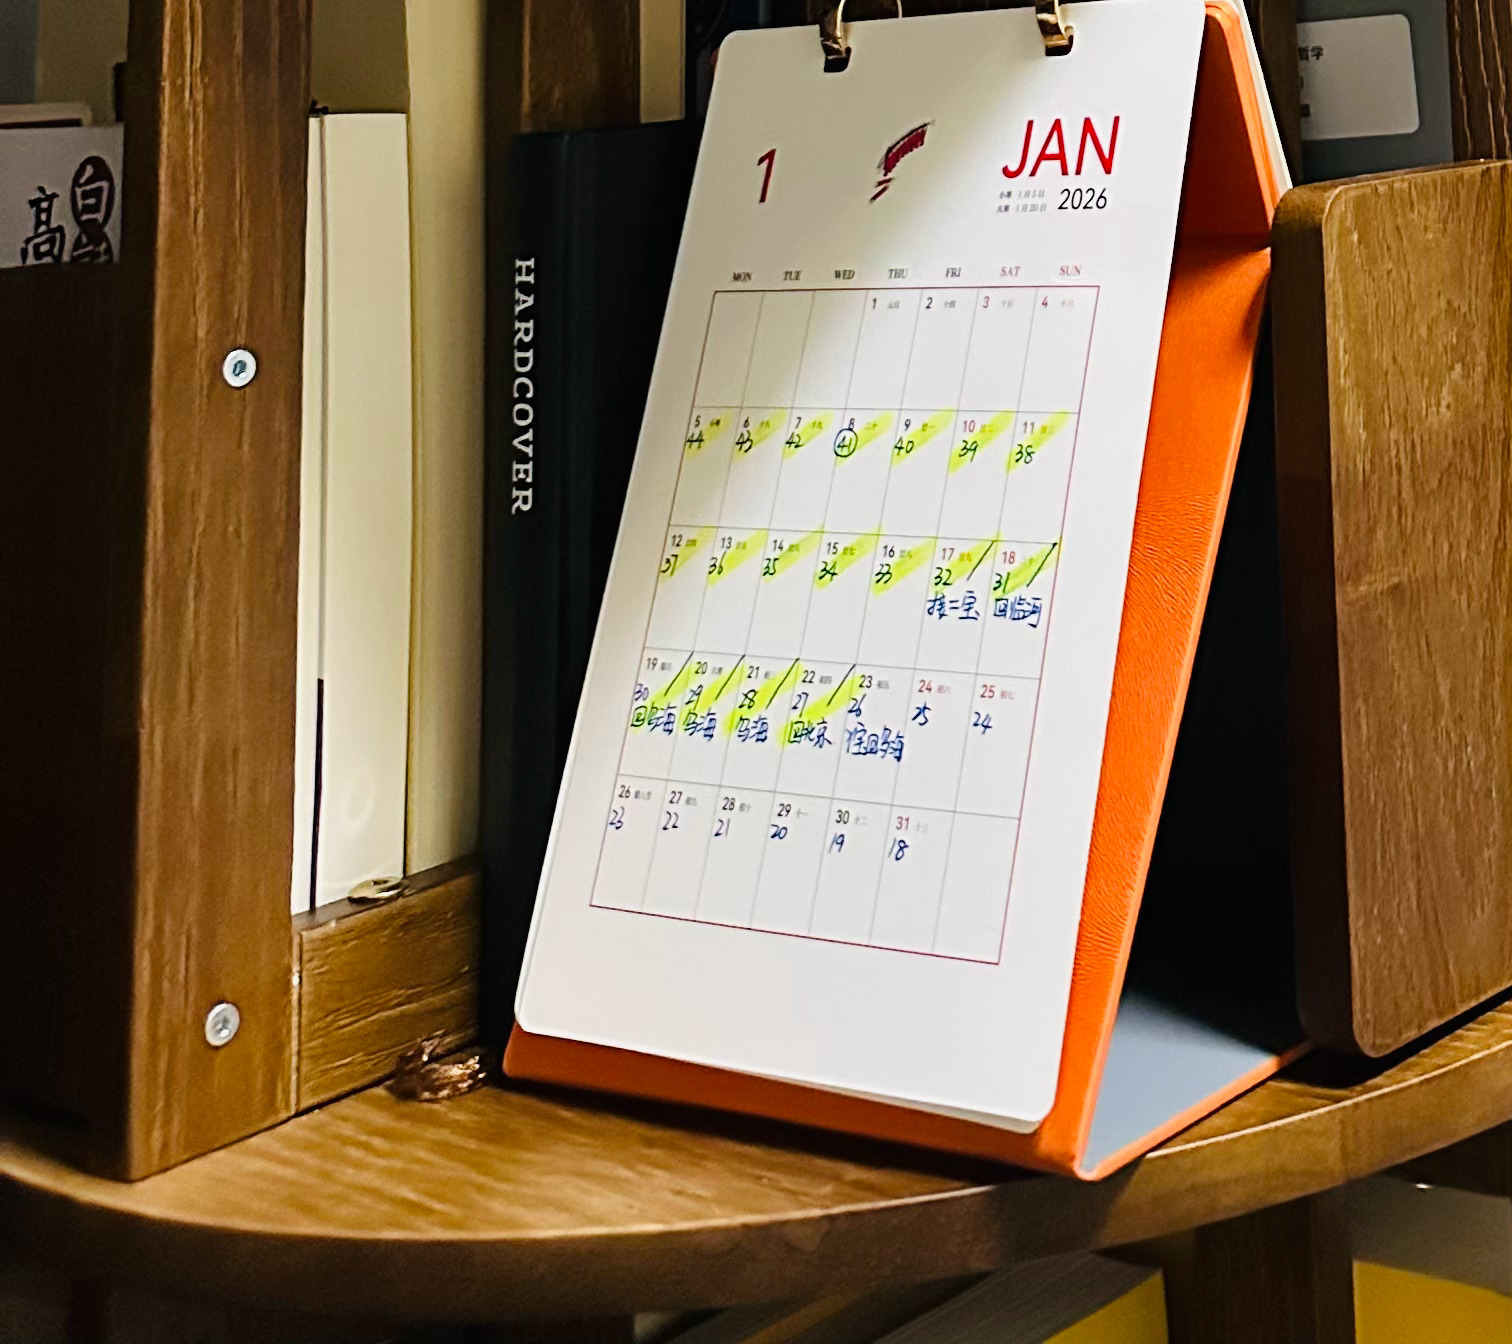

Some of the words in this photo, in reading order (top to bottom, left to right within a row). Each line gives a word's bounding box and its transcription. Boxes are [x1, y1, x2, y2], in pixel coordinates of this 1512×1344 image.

[757, 148, 777, 203] 1
[1002, 116, 1120, 178] JAN
[1058, 188, 1107, 210] 2026
[732, 272, 753, 282] MON
[783, 270, 801, 280] TUE
[834, 269, 855, 280] WED
[888, 268, 908, 279] THU
[945, 267, 961, 278] FRI
[1000, 266, 1022, 277] SAT
[1059, 265, 1082, 276] SUN
[926, 297, 933, 309] 2
[983, 296, 990, 308] 3
[1041, 296, 1048, 307] 4
[510, 257, 536, 515] HARDCOVER
[695, 416, 701, 427] 5
[743, 417, 750, 428] 6
[796, 417, 802, 429] 7
[848, 418, 855, 429] 8
[904, 418, 911, 431] 9
[963, 420, 975, 432] 10
[1023, 421, 1035, 434] 11
[687, 431, 704, 449] 44
[736, 430, 753, 452] 43
[785, 432, 806, 448] 42
[894, 436, 914, 456] 40
[958, 440, 979, 462] 39
[1015, 443, 1035, 464] 38
[671, 534, 683, 547] 12
[721, 536, 732, 549] 13
[773, 539, 784, 551] 14
[827, 542, 838, 555] 15
[883, 545, 894, 558] 16
[942, 548, 954, 561] 17
[1002, 551, 1015, 564] 18
[661, 554, 678, 577] 37
[708, 551, 726, 575] 36
[763, 558, 779, 576] 35
[818, 561, 838, 582] 34
[875, 564, 893, 584] 33
[934, 567, 953, 586] 32
[993, 572, 1010, 594] 31
[647, 657, 658, 670] 19
[695, 662, 707, 675] 20
[747, 666, 759, 679] 21
[802, 670, 815, 684] 22
[859, 675, 872, 688] 23
[918, 680, 932, 693] 24
[980, 684, 995, 698] 25
[633, 683, 648, 701] 30
[685, 685, 703, 710] 29
[739, 689, 758, 709] 28
[792, 692, 809, 718] 27
[848, 693, 867, 717] 26
[972, 711, 993, 736] 24
[619, 785, 631, 799] 26
[669, 790, 682, 804] 27
[722, 797, 736, 811] 28
[777, 803, 791, 817] 29
[836, 809, 849, 824] 30
[896, 816, 909, 830] 31
[608, 806, 625, 829] 23
[662, 811, 679, 830] 22
[714, 818, 731, 837] 21
[770, 824, 788, 839] 20
[829, 833, 845, 853] 19
[888, 837, 909, 861] 18
